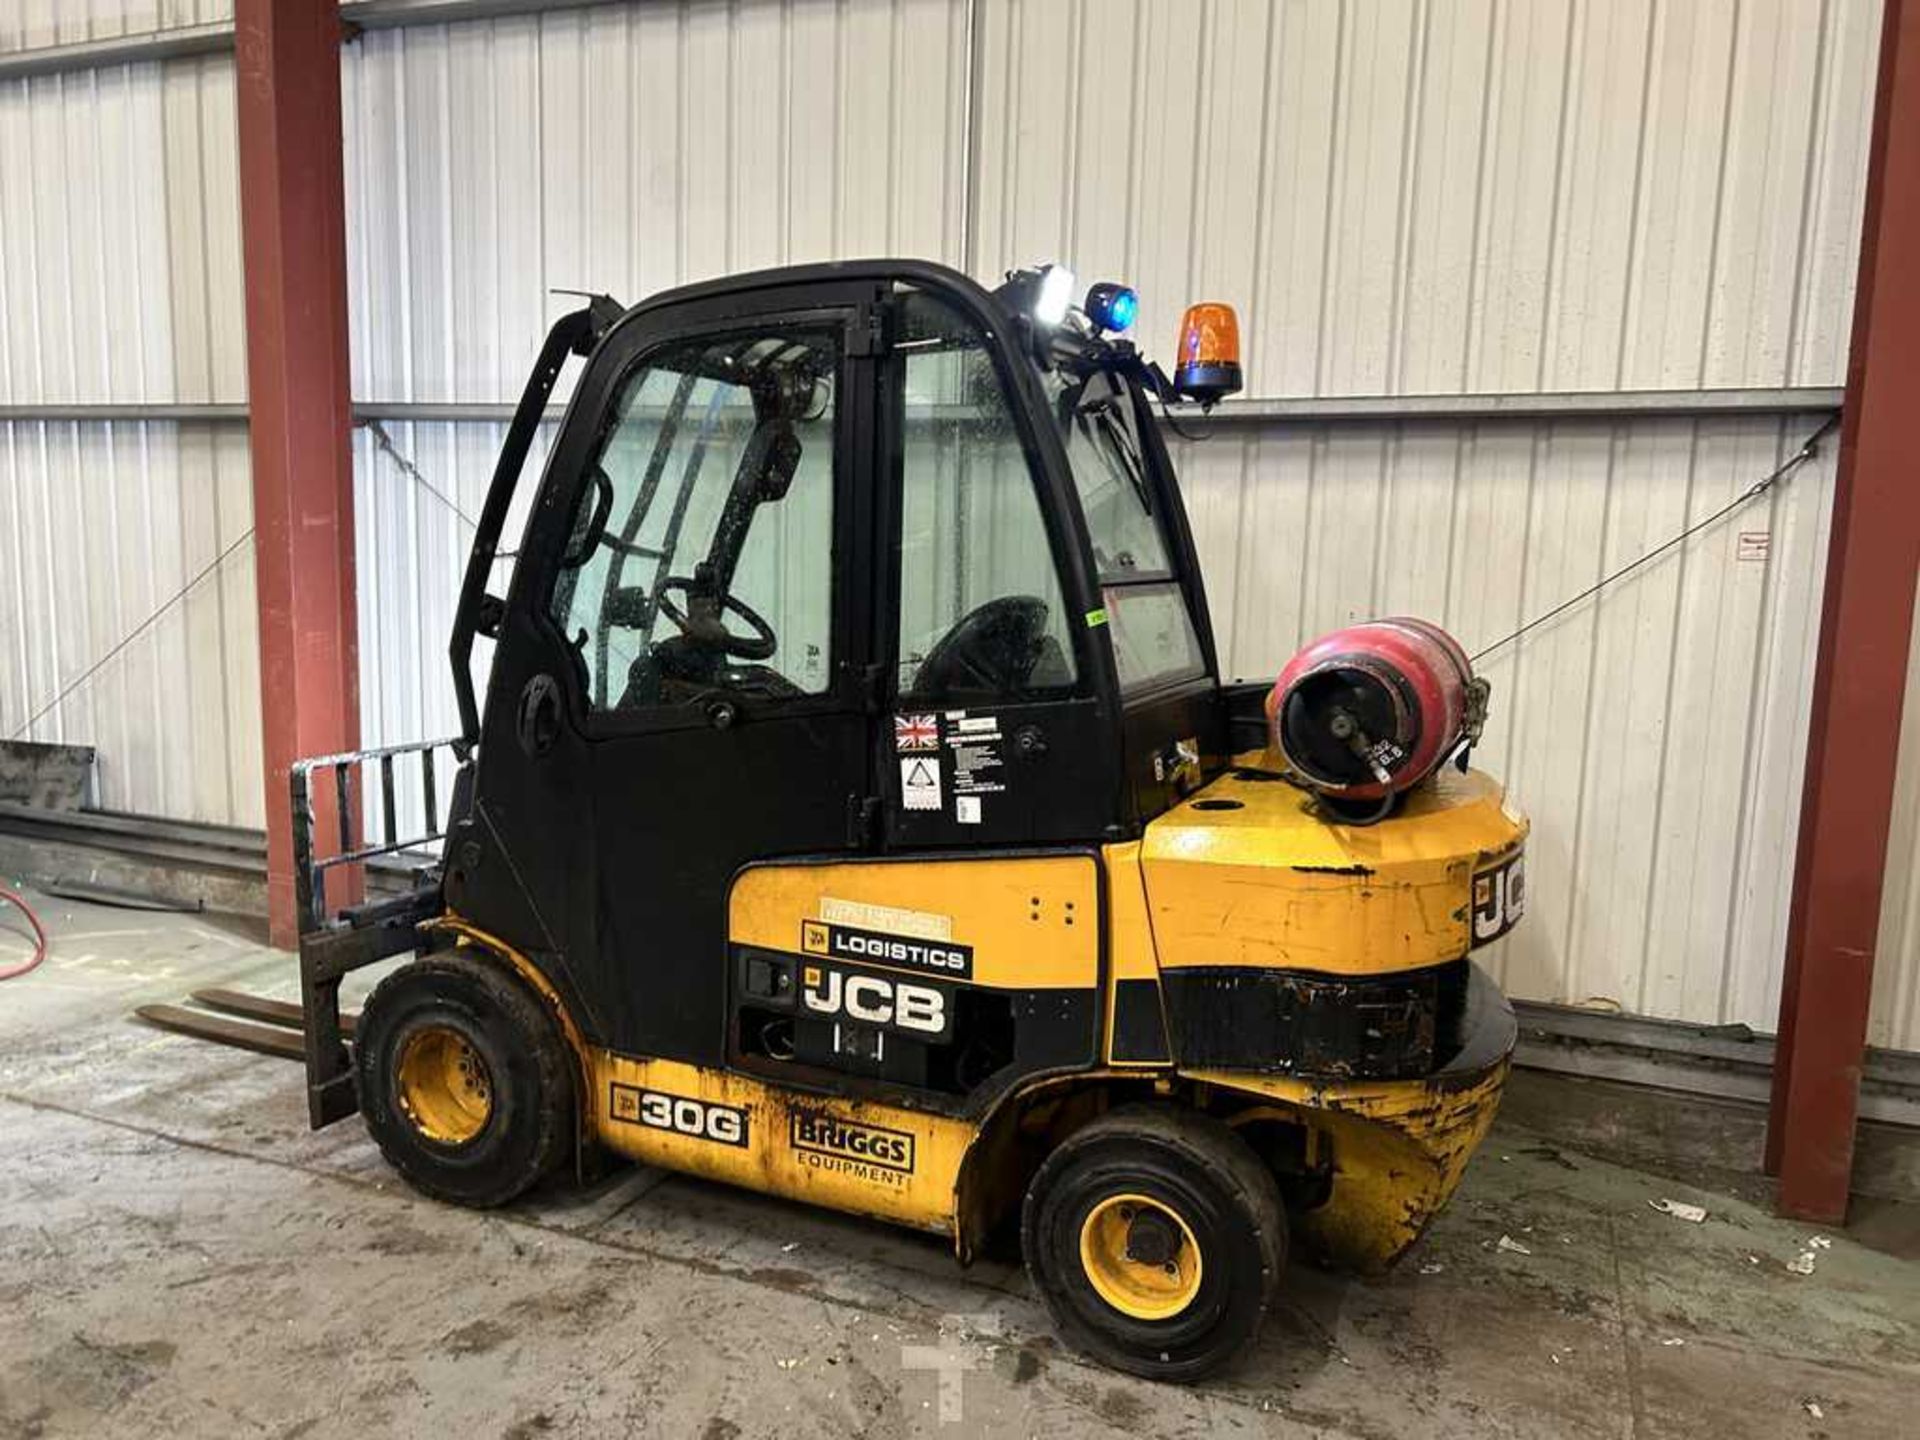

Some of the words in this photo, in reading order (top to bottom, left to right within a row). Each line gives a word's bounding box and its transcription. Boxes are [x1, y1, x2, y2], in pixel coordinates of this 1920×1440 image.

[836, 934, 965, 969] LOGISTICS
[804, 970, 945, 1033] JCB
[641, 1093, 741, 1143] 30G
[798, 1112, 905, 1163] BRIGGS
[797, 1152, 907, 1187] EQUIPMENT
